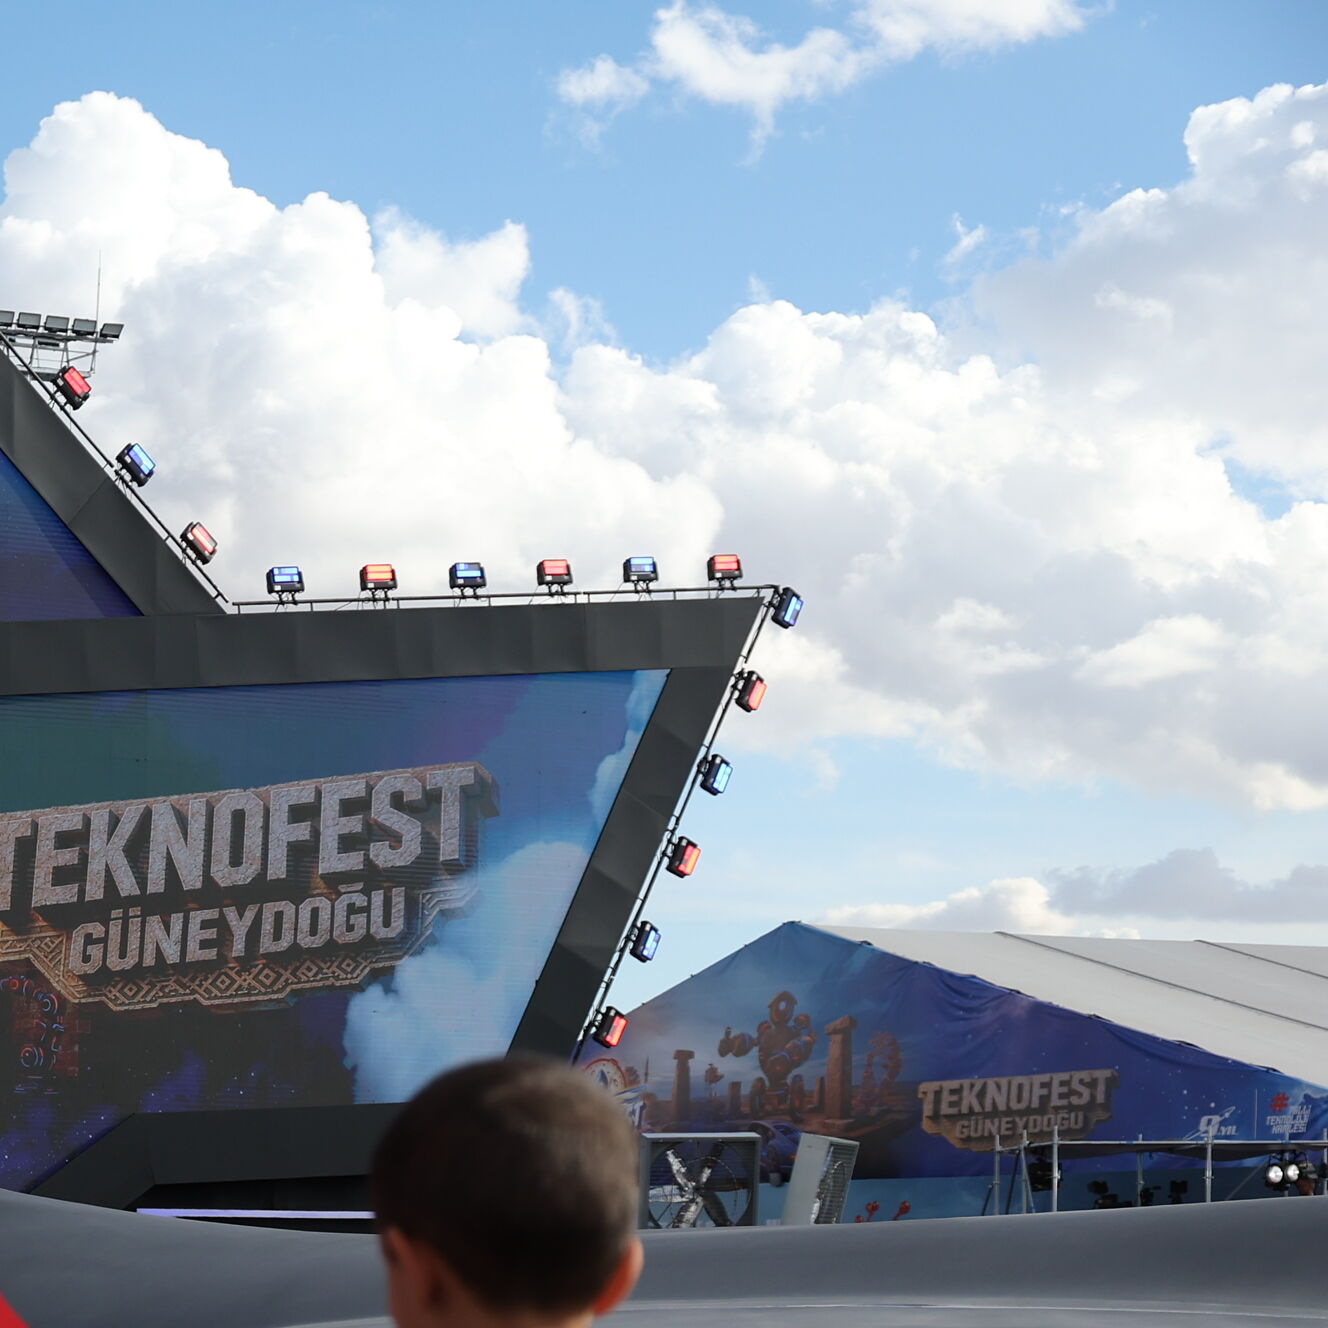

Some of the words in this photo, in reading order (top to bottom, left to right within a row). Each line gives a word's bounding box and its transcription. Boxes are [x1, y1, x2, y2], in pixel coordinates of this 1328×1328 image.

[68, 882, 406, 976] GÜNEYDOĞU
[920, 1069, 1113, 1117] TEKNOFEST
[957, 1110, 1084, 1139] GÜNEYDOĞU
